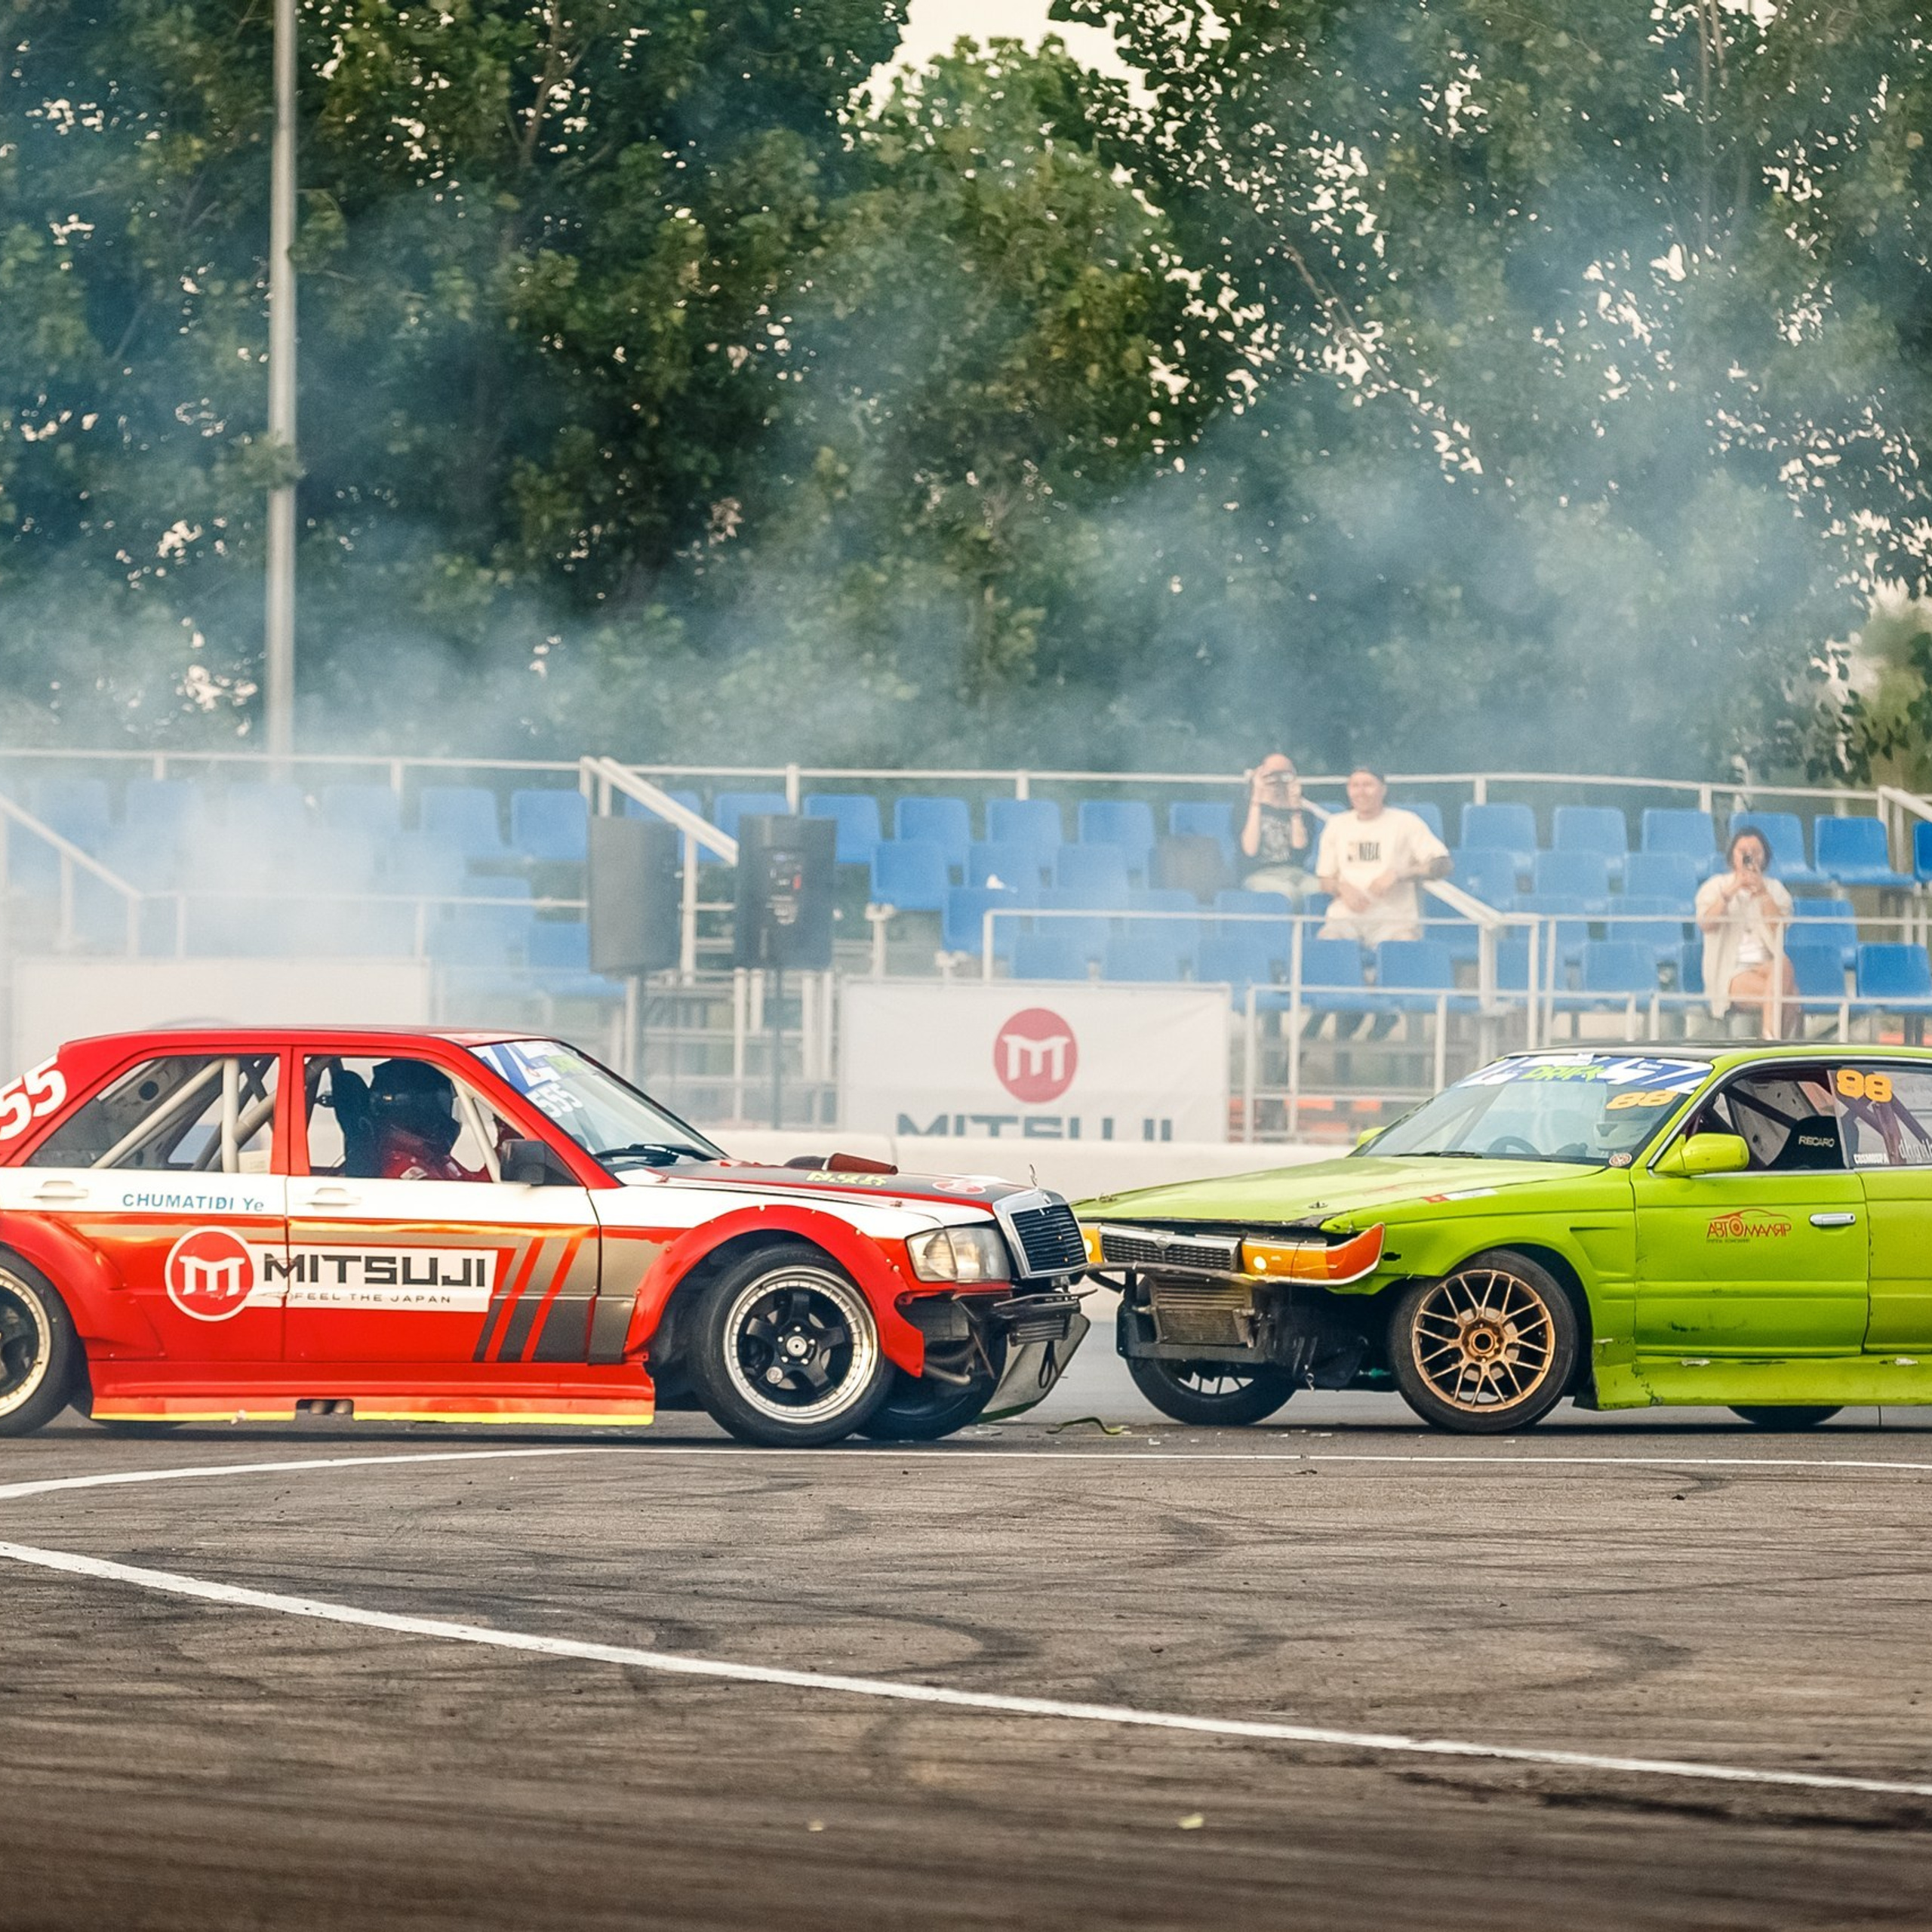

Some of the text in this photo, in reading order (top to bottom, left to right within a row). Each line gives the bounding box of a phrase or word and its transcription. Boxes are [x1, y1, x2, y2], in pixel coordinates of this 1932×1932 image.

[1835, 1069, 1893, 1103] 88
[1605, 1090, 1678, 1110] 88
[1798, 1135, 1835, 1148] RECARO
[122, 1193, 264, 1212] CHUMATIDI Ye
[264, 1253, 485, 1287] MITSUJI
[294, 1293, 451, 1303] FEEL THE JAPAN
